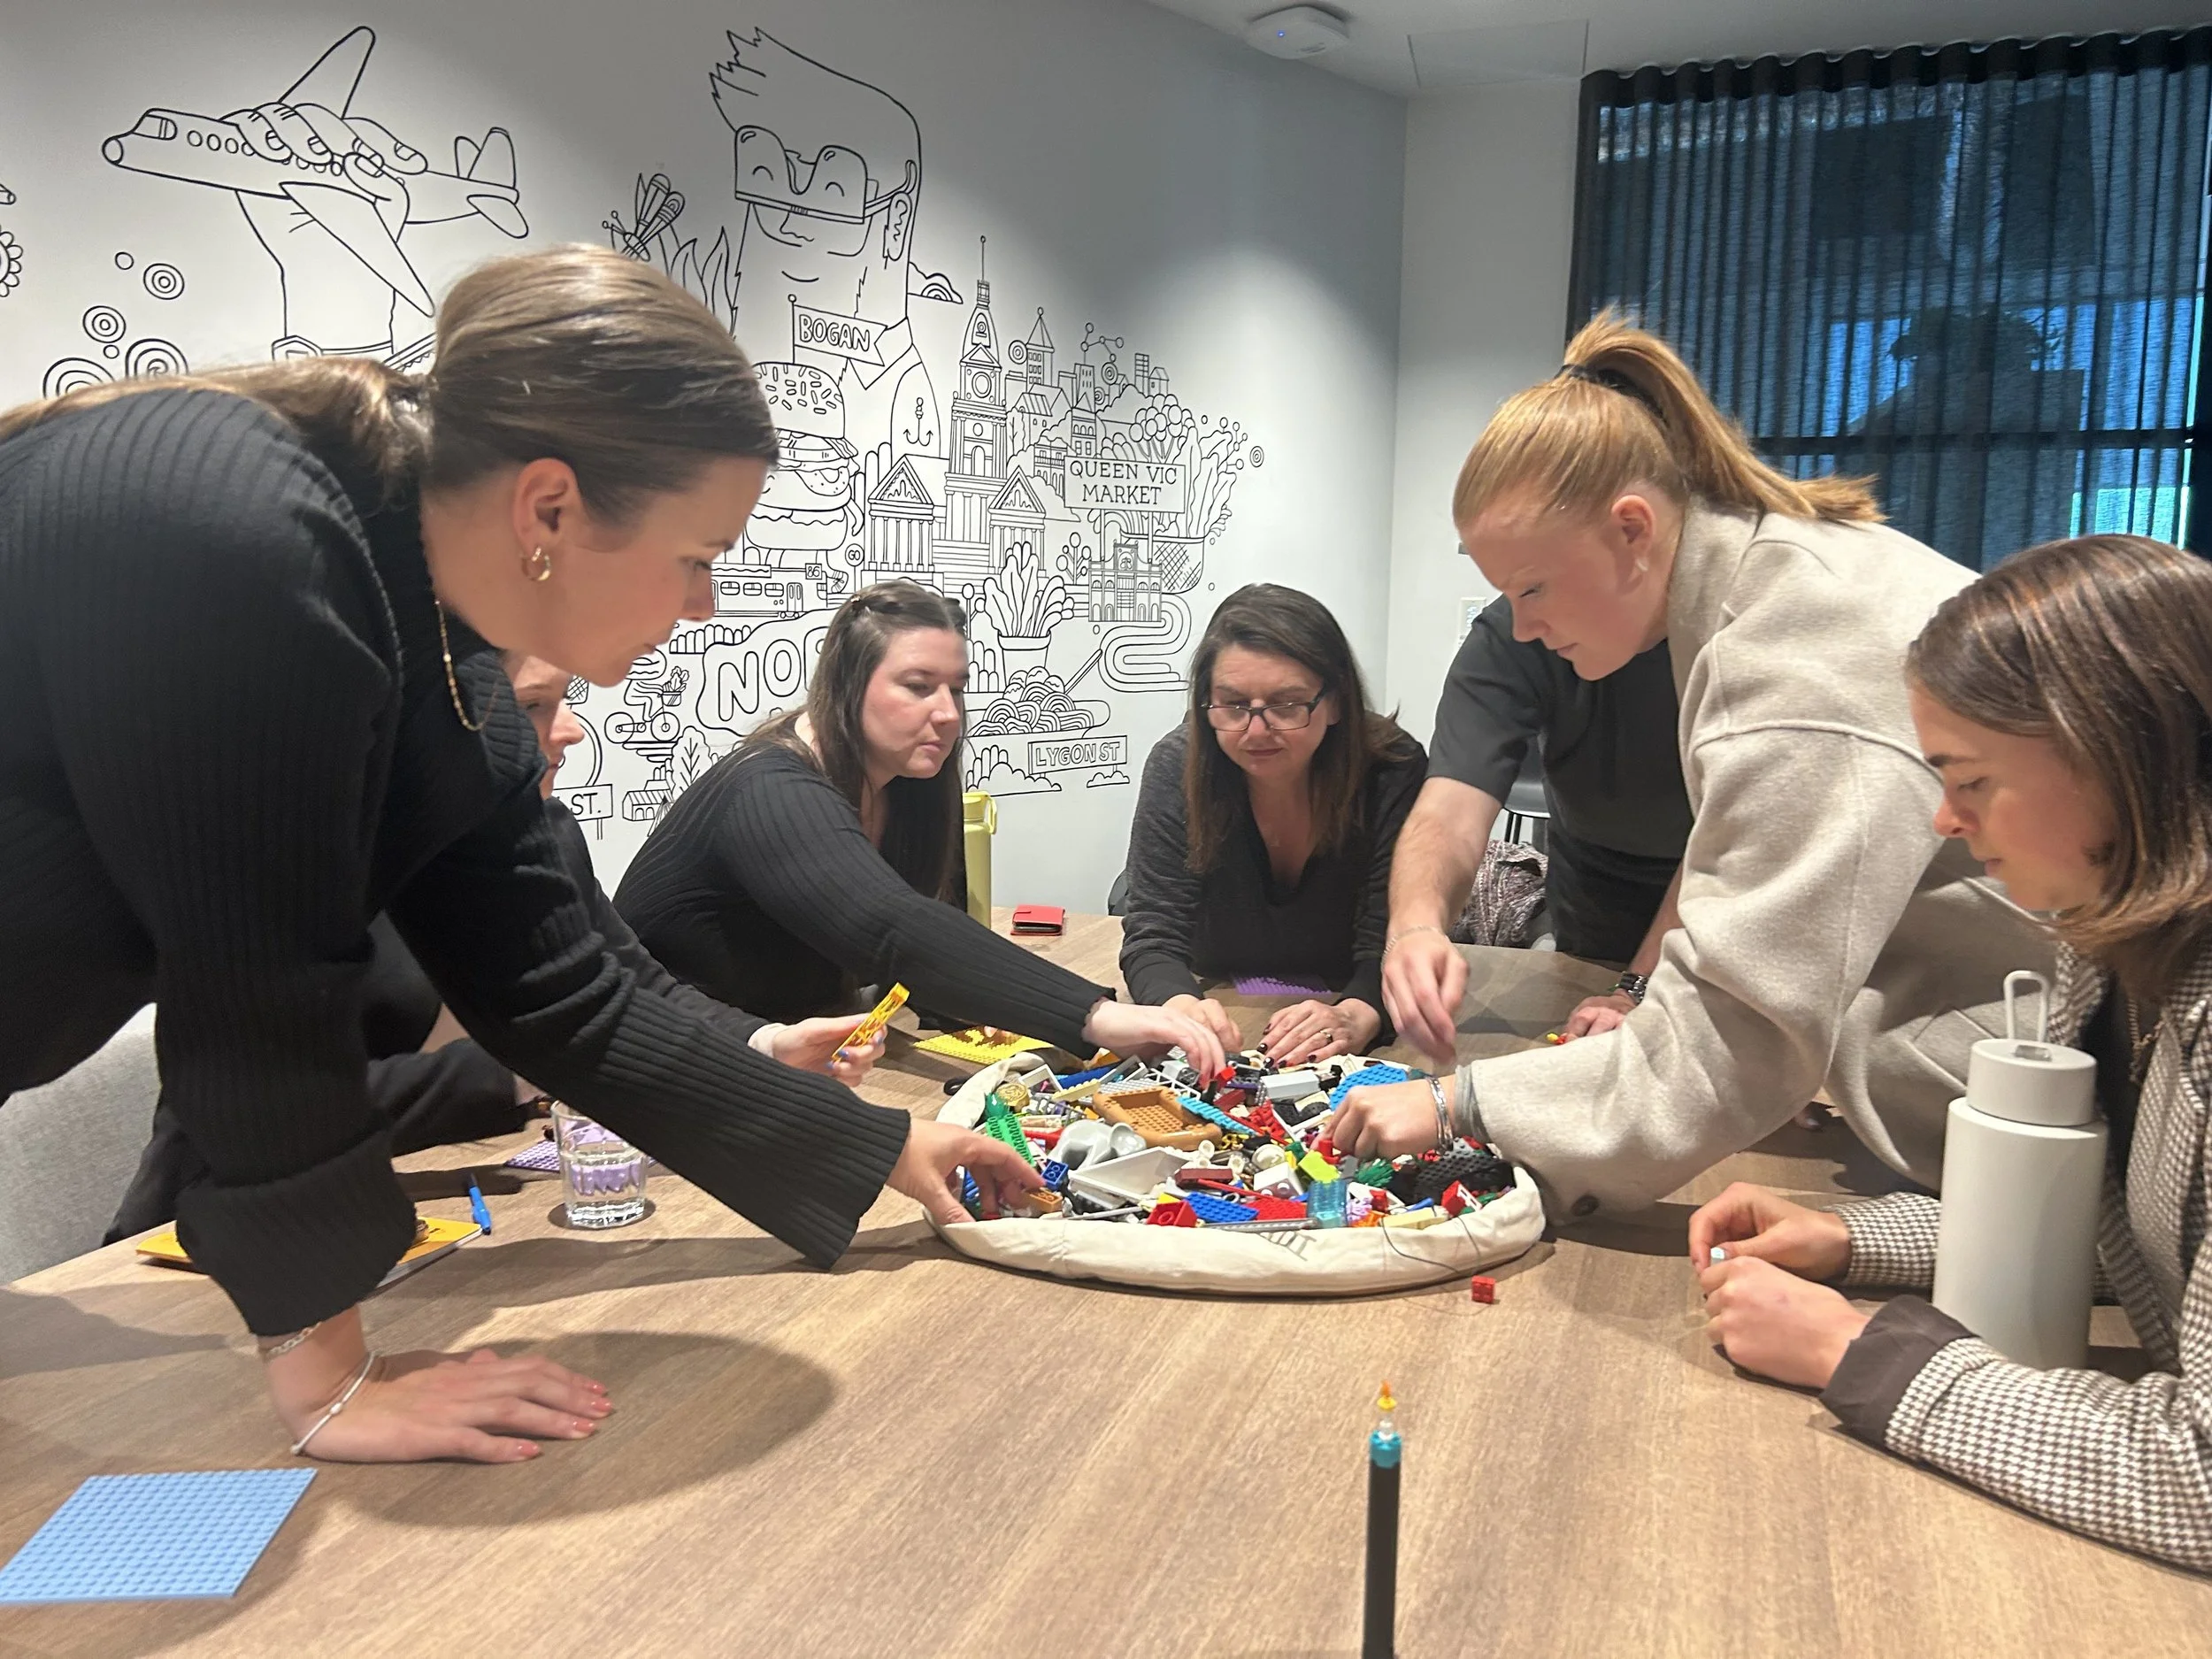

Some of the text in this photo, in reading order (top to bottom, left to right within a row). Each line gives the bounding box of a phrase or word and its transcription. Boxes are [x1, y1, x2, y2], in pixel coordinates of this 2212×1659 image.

[799, 314, 871, 352] BOGAN
[1070, 460, 1177, 485] QUEEN VIC
[1082, 484, 1162, 505] MARKET
[848, 549, 861, 561] GO
[807, 565, 820, 578] 86
[1035, 741, 1120, 766] LYGON ST
